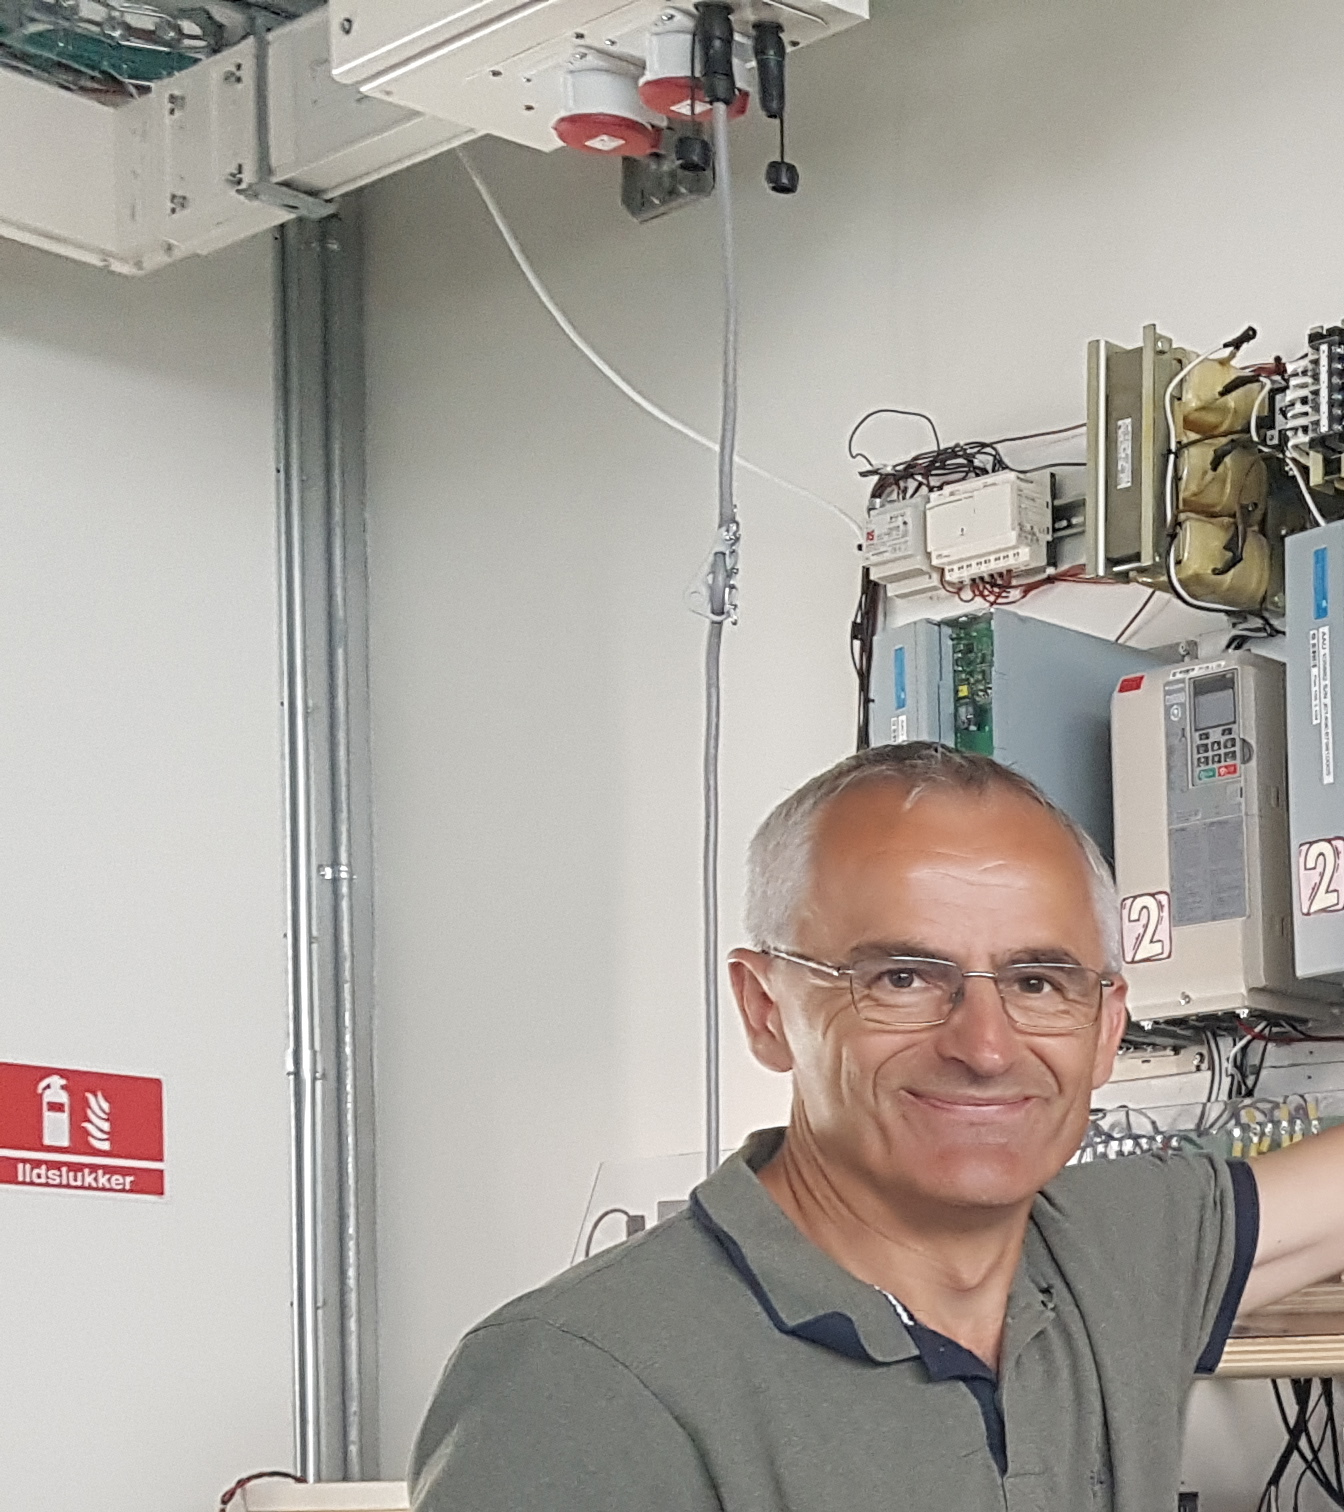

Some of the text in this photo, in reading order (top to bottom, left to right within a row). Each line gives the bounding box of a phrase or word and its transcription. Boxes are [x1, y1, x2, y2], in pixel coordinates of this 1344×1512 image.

[1304, 840, 1340, 915] 2
[1128, 894, 1164, 963] 2
[16, 1162, 135, 1191] Ildslukker
